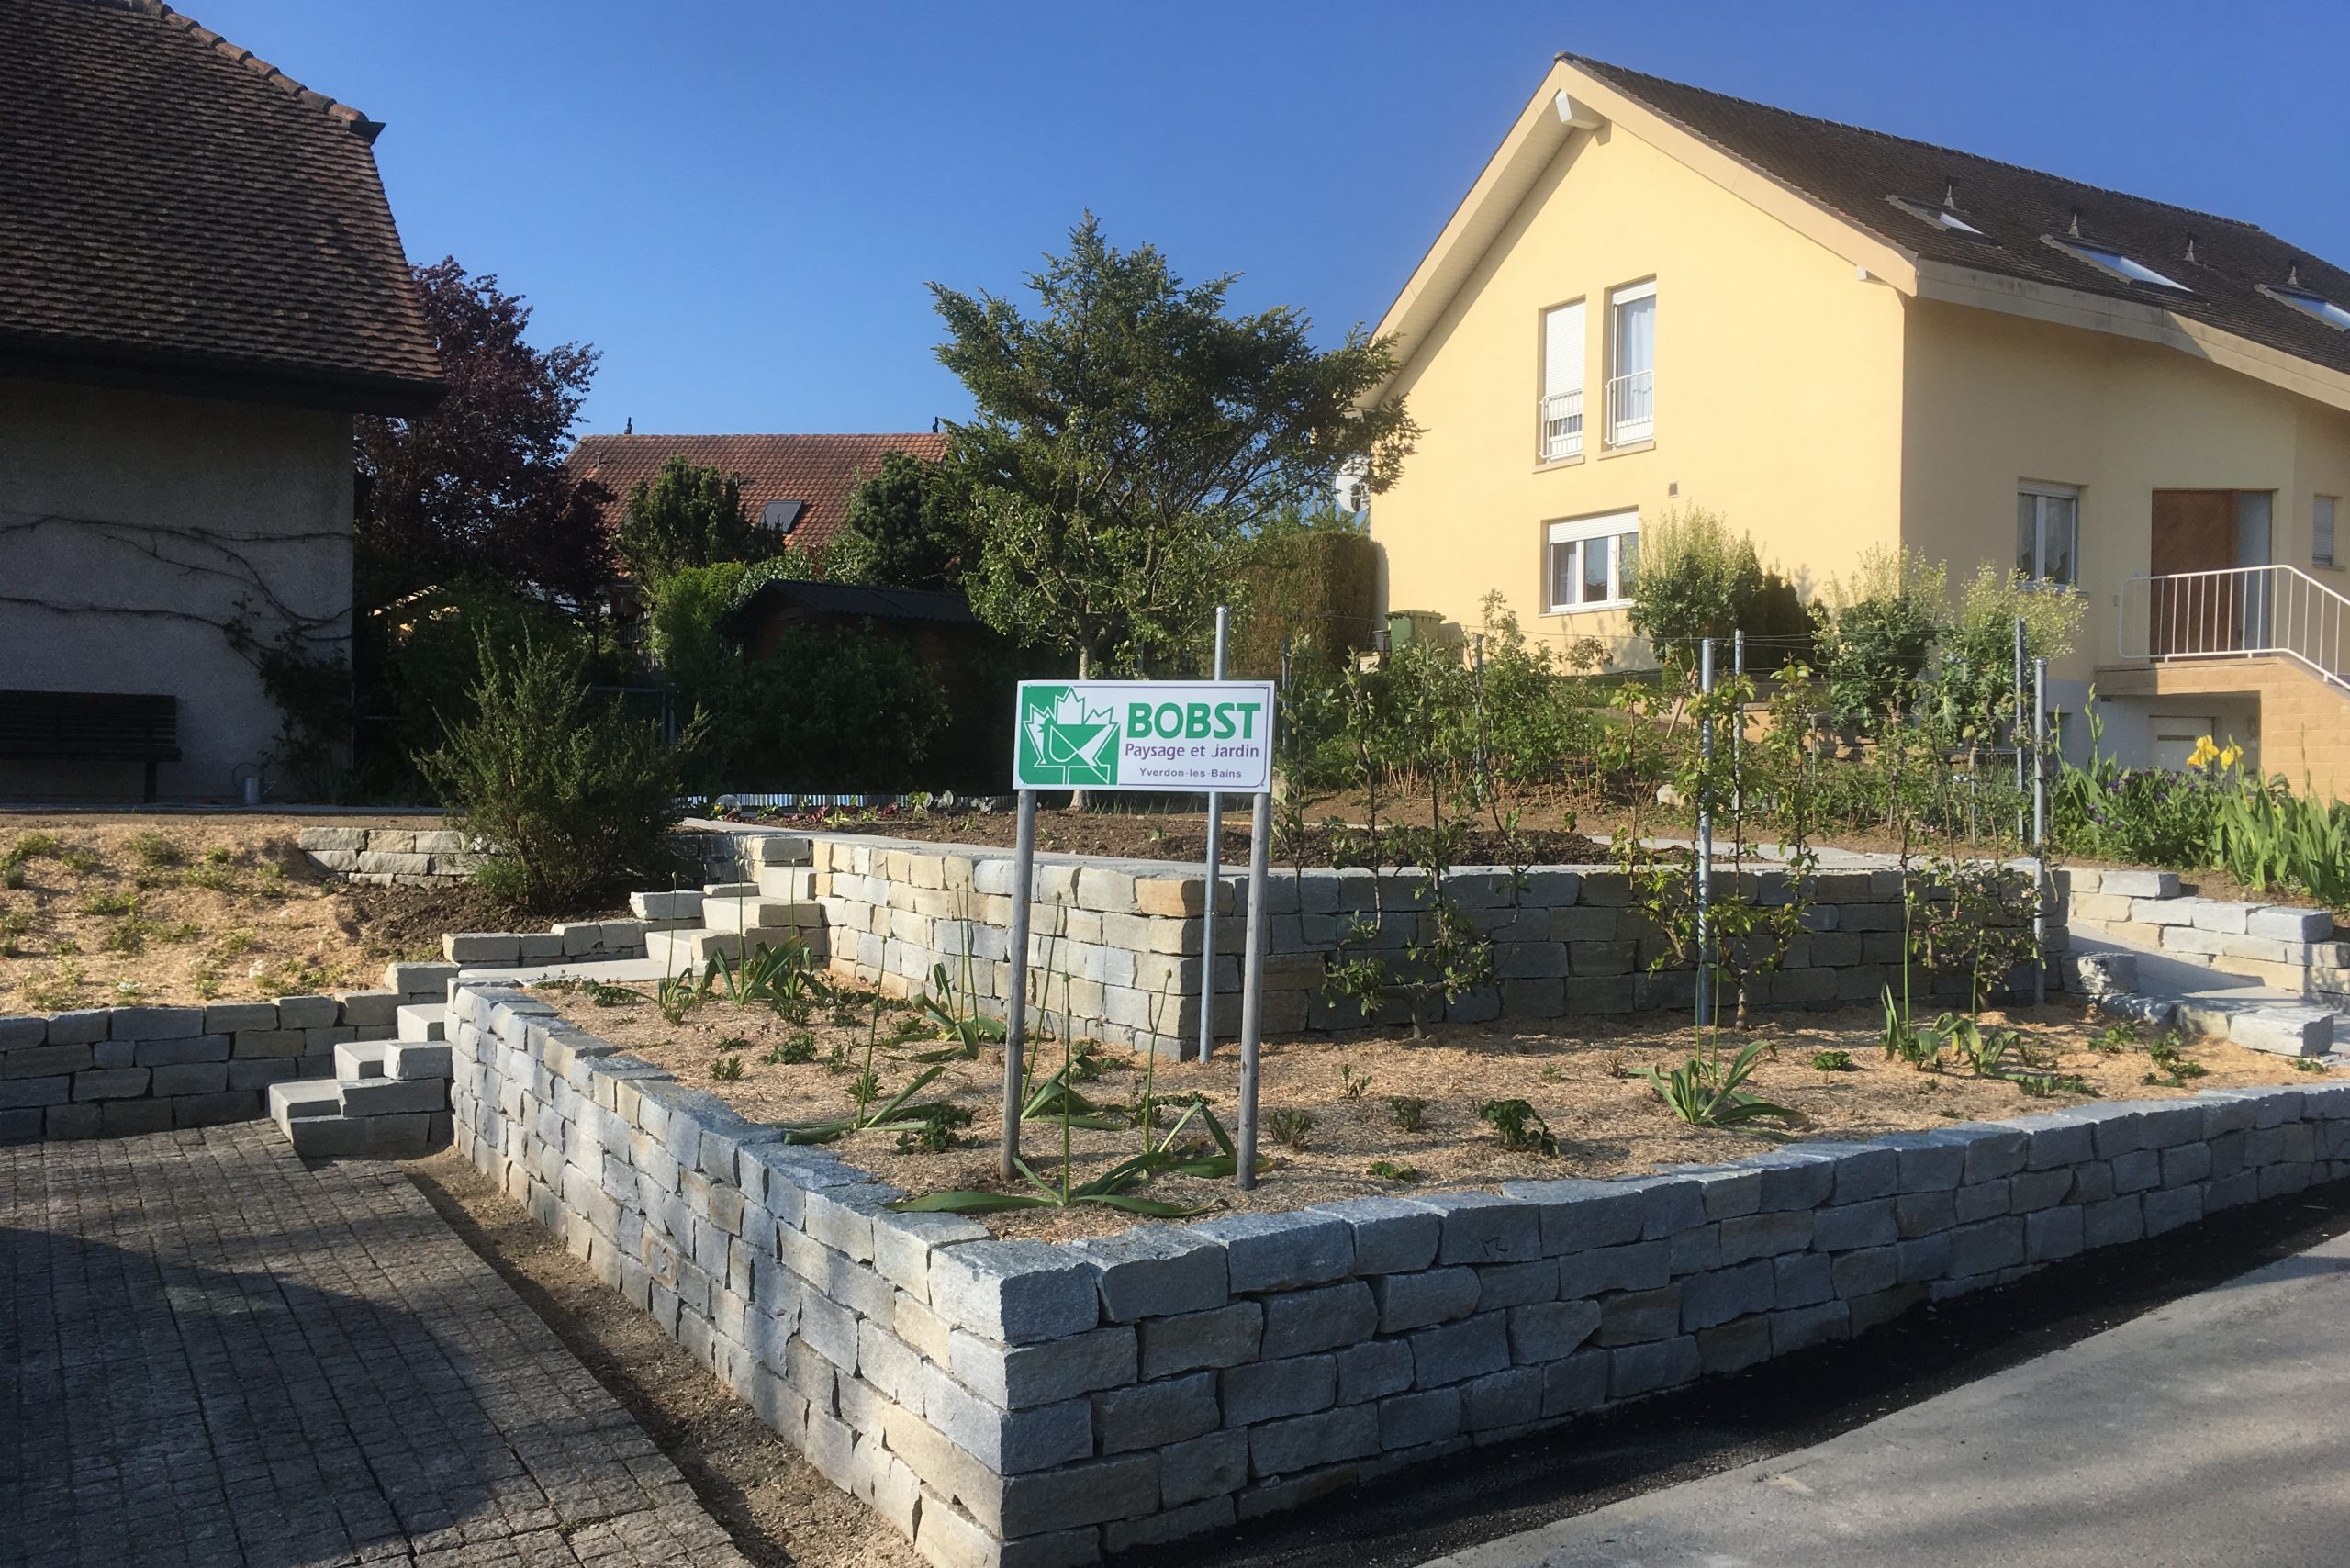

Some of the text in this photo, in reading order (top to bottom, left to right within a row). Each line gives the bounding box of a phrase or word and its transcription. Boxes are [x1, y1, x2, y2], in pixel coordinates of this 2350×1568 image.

[1127, 702, 1261, 739] BOBST
[1125, 743, 1259, 760] Paysage et jardin
[1139, 767, 1242, 778] Yverdon-les-Bains
